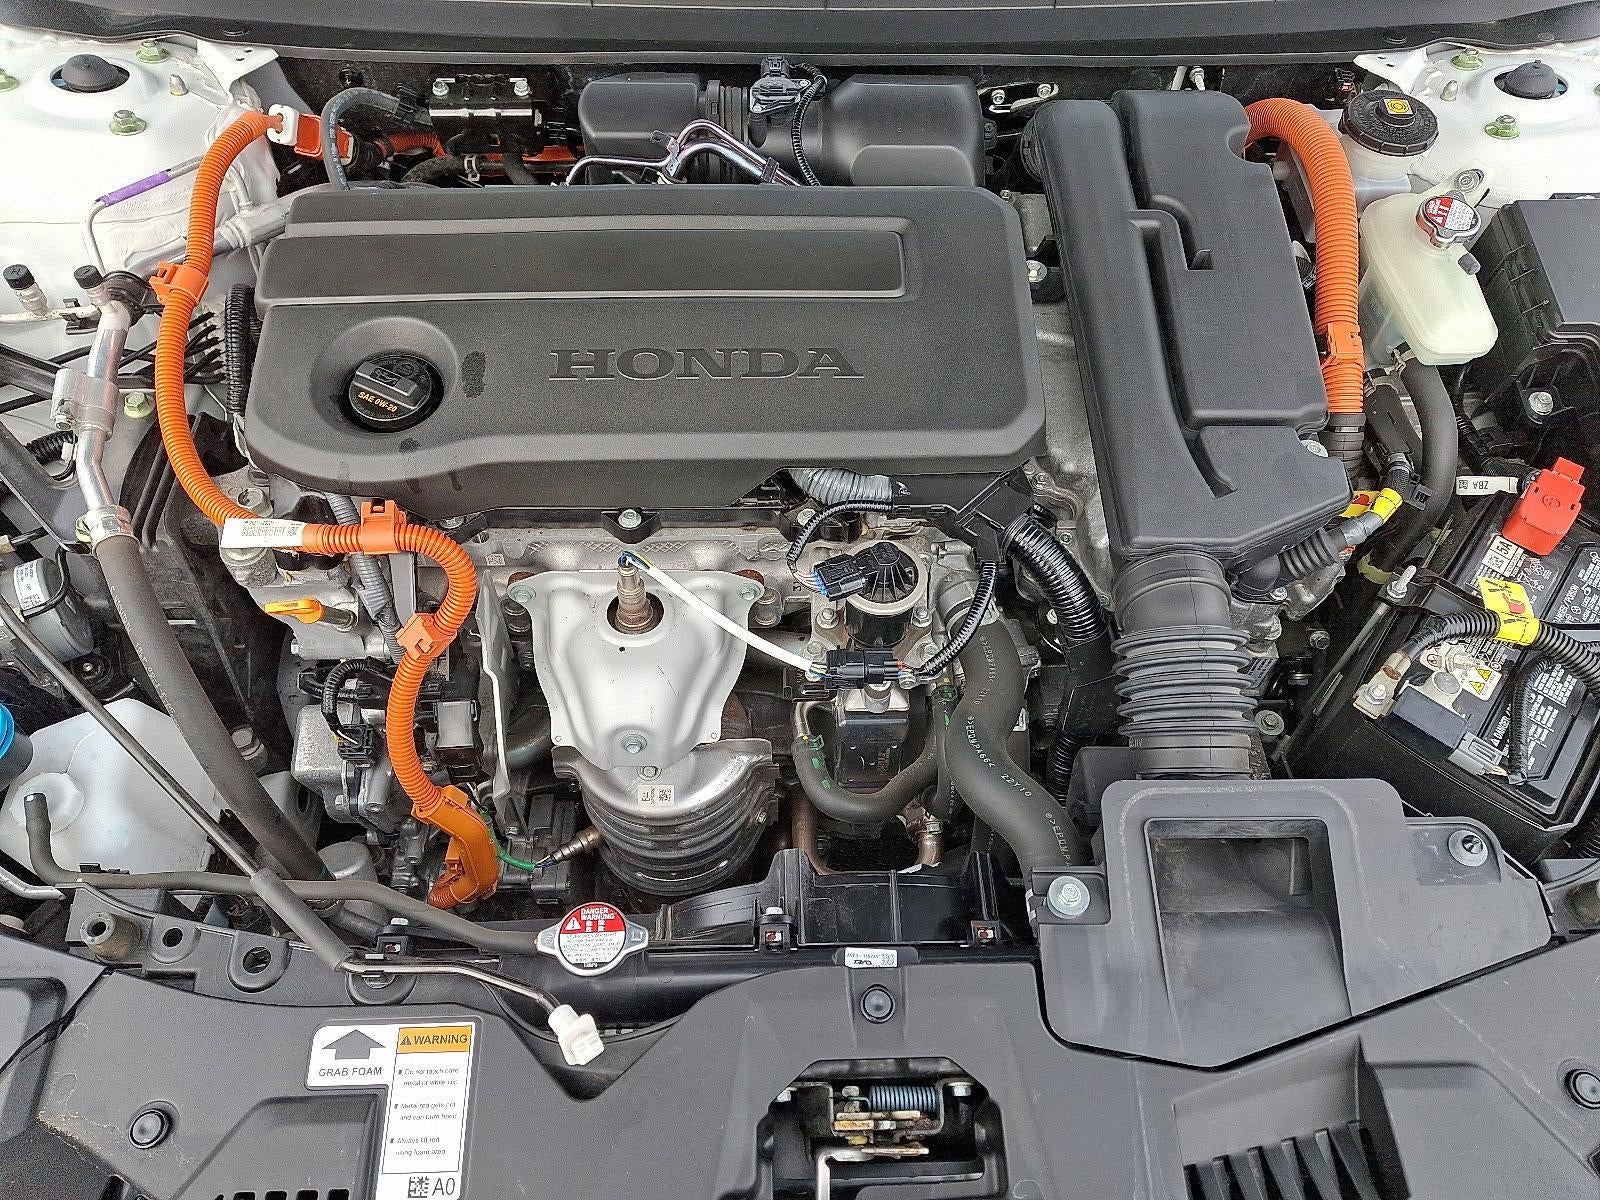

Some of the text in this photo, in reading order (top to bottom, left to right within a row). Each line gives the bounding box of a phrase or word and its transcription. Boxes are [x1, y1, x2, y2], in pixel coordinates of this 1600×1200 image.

[548, 348, 865, 380] HONDA
[358, 391, 376, 403] SAE
[374, 398, 398, 412] 0W-20
[1500, 539, 1513, 559] 5A
[581, 907, 609, 915] DANGER
[413, 1034, 468, 1045] WARNING
[319, 1066, 383, 1077] GRAB FOAM
[432, 1177, 456, 1196] A0
